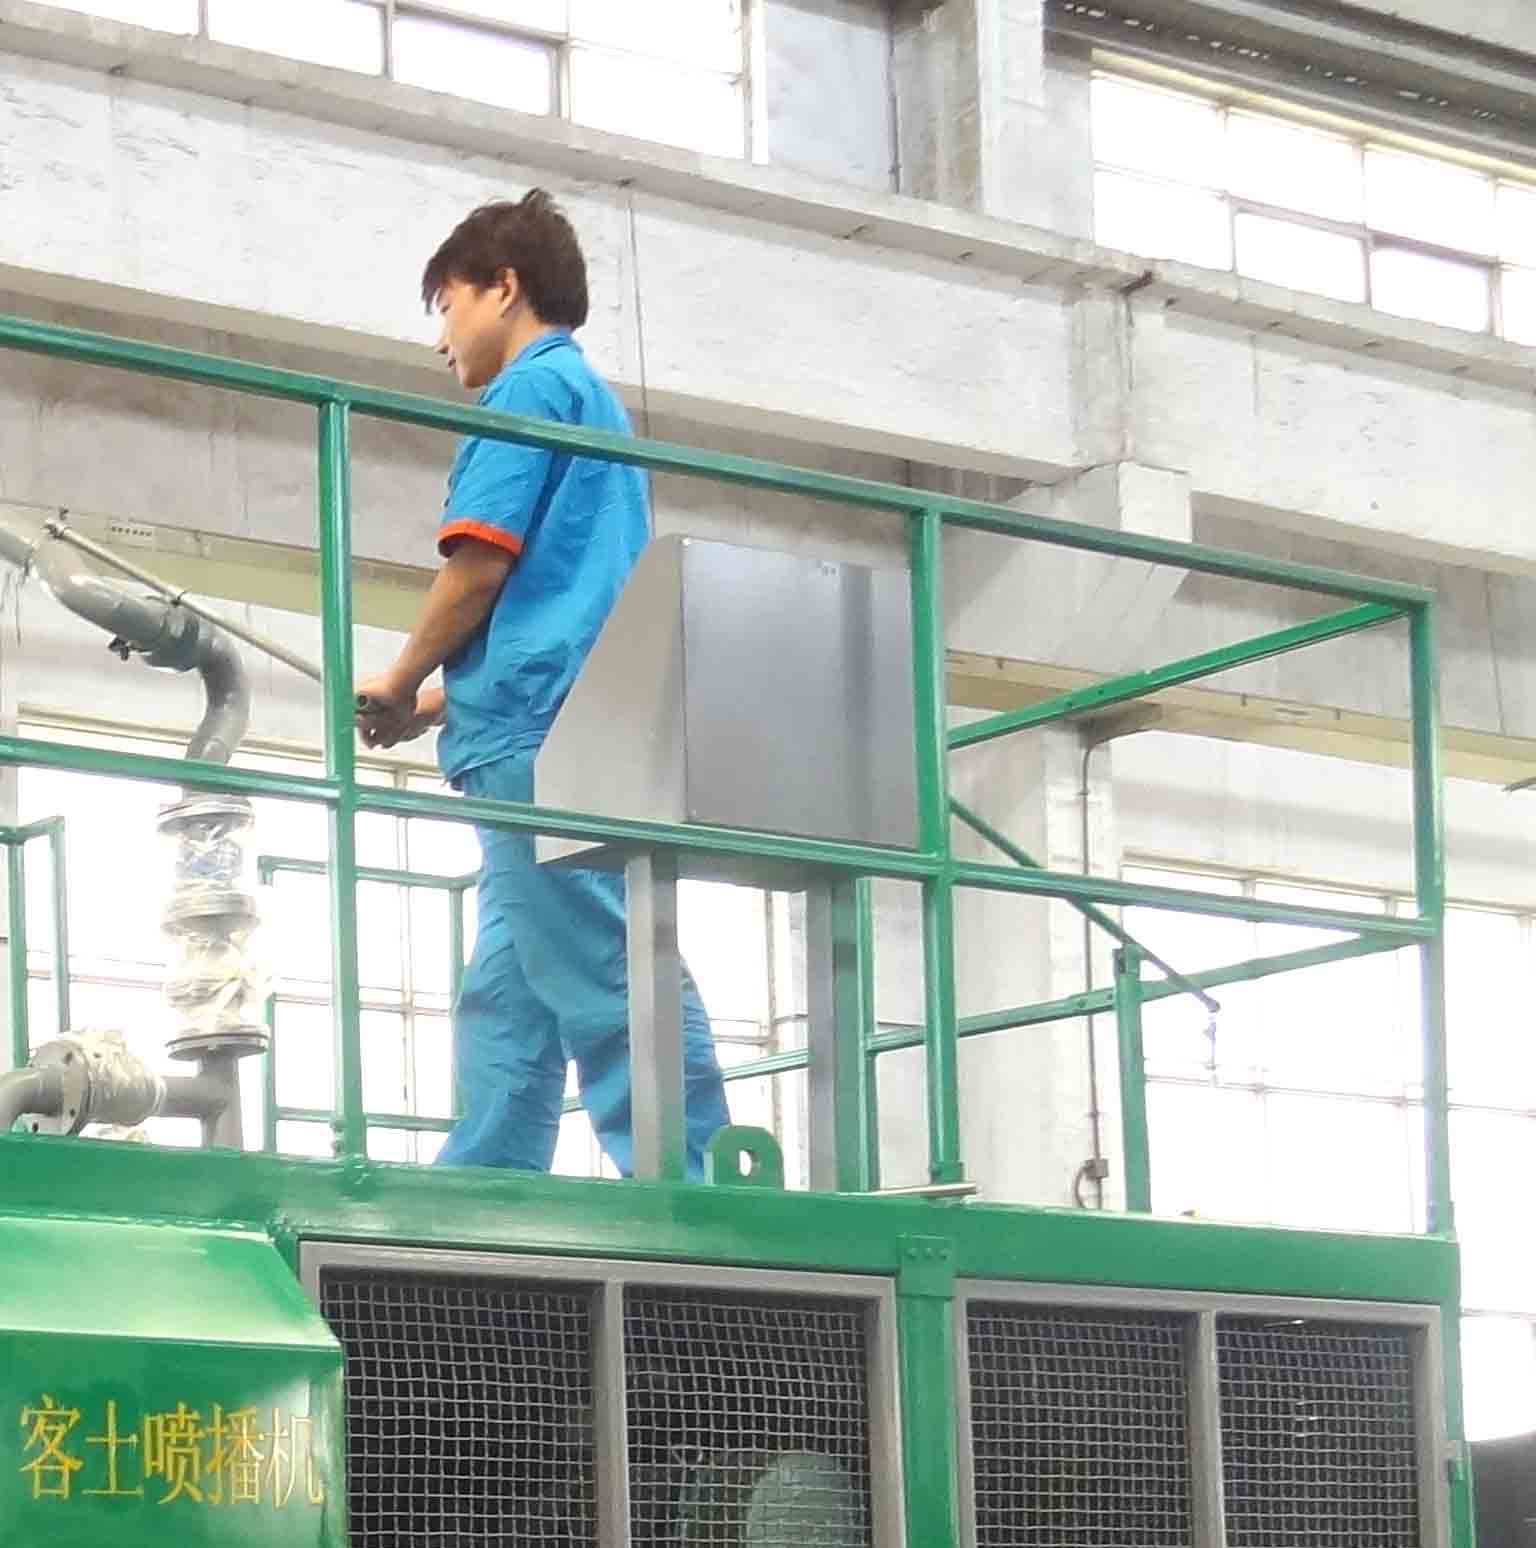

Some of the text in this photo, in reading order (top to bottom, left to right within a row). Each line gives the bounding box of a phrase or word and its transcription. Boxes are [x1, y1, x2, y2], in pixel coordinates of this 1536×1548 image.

[18, 1394, 325, 1508] 客土喷播机
